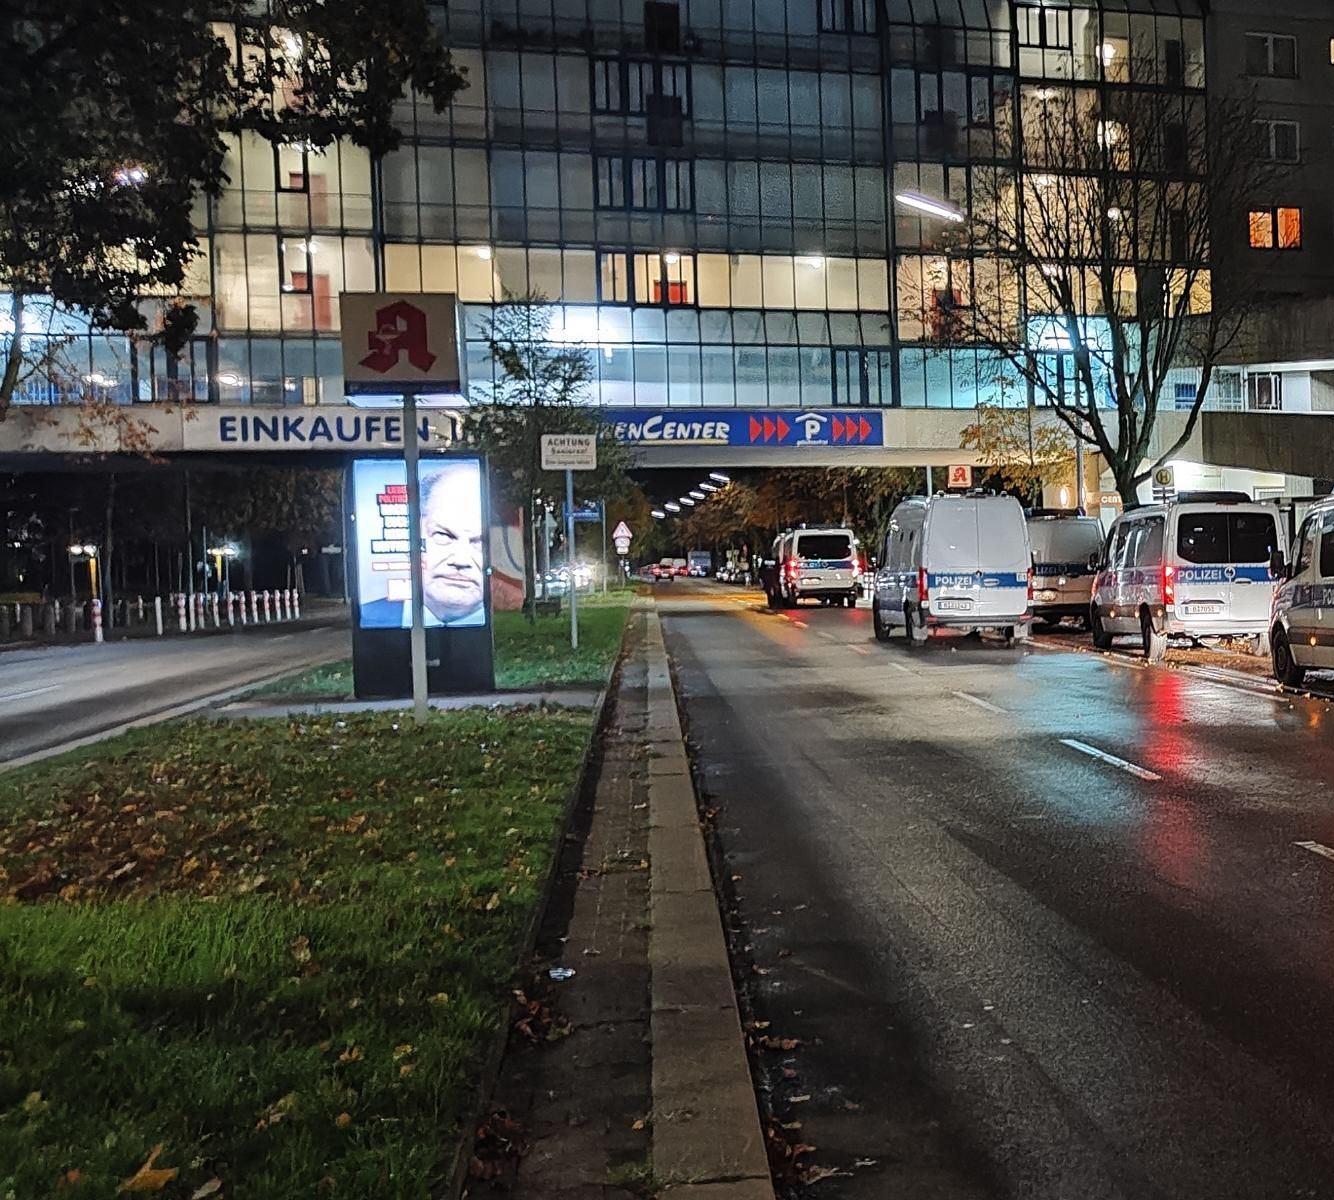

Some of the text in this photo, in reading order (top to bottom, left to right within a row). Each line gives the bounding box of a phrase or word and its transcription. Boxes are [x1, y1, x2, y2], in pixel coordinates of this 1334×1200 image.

[219, 416, 429, 443] EINKAUFEN
[547, 438, 591, 446] ACHTUNG
[1178, 569, 1222, 580] POLIZEI
[935, 576, 973, 585] POLIZEI
